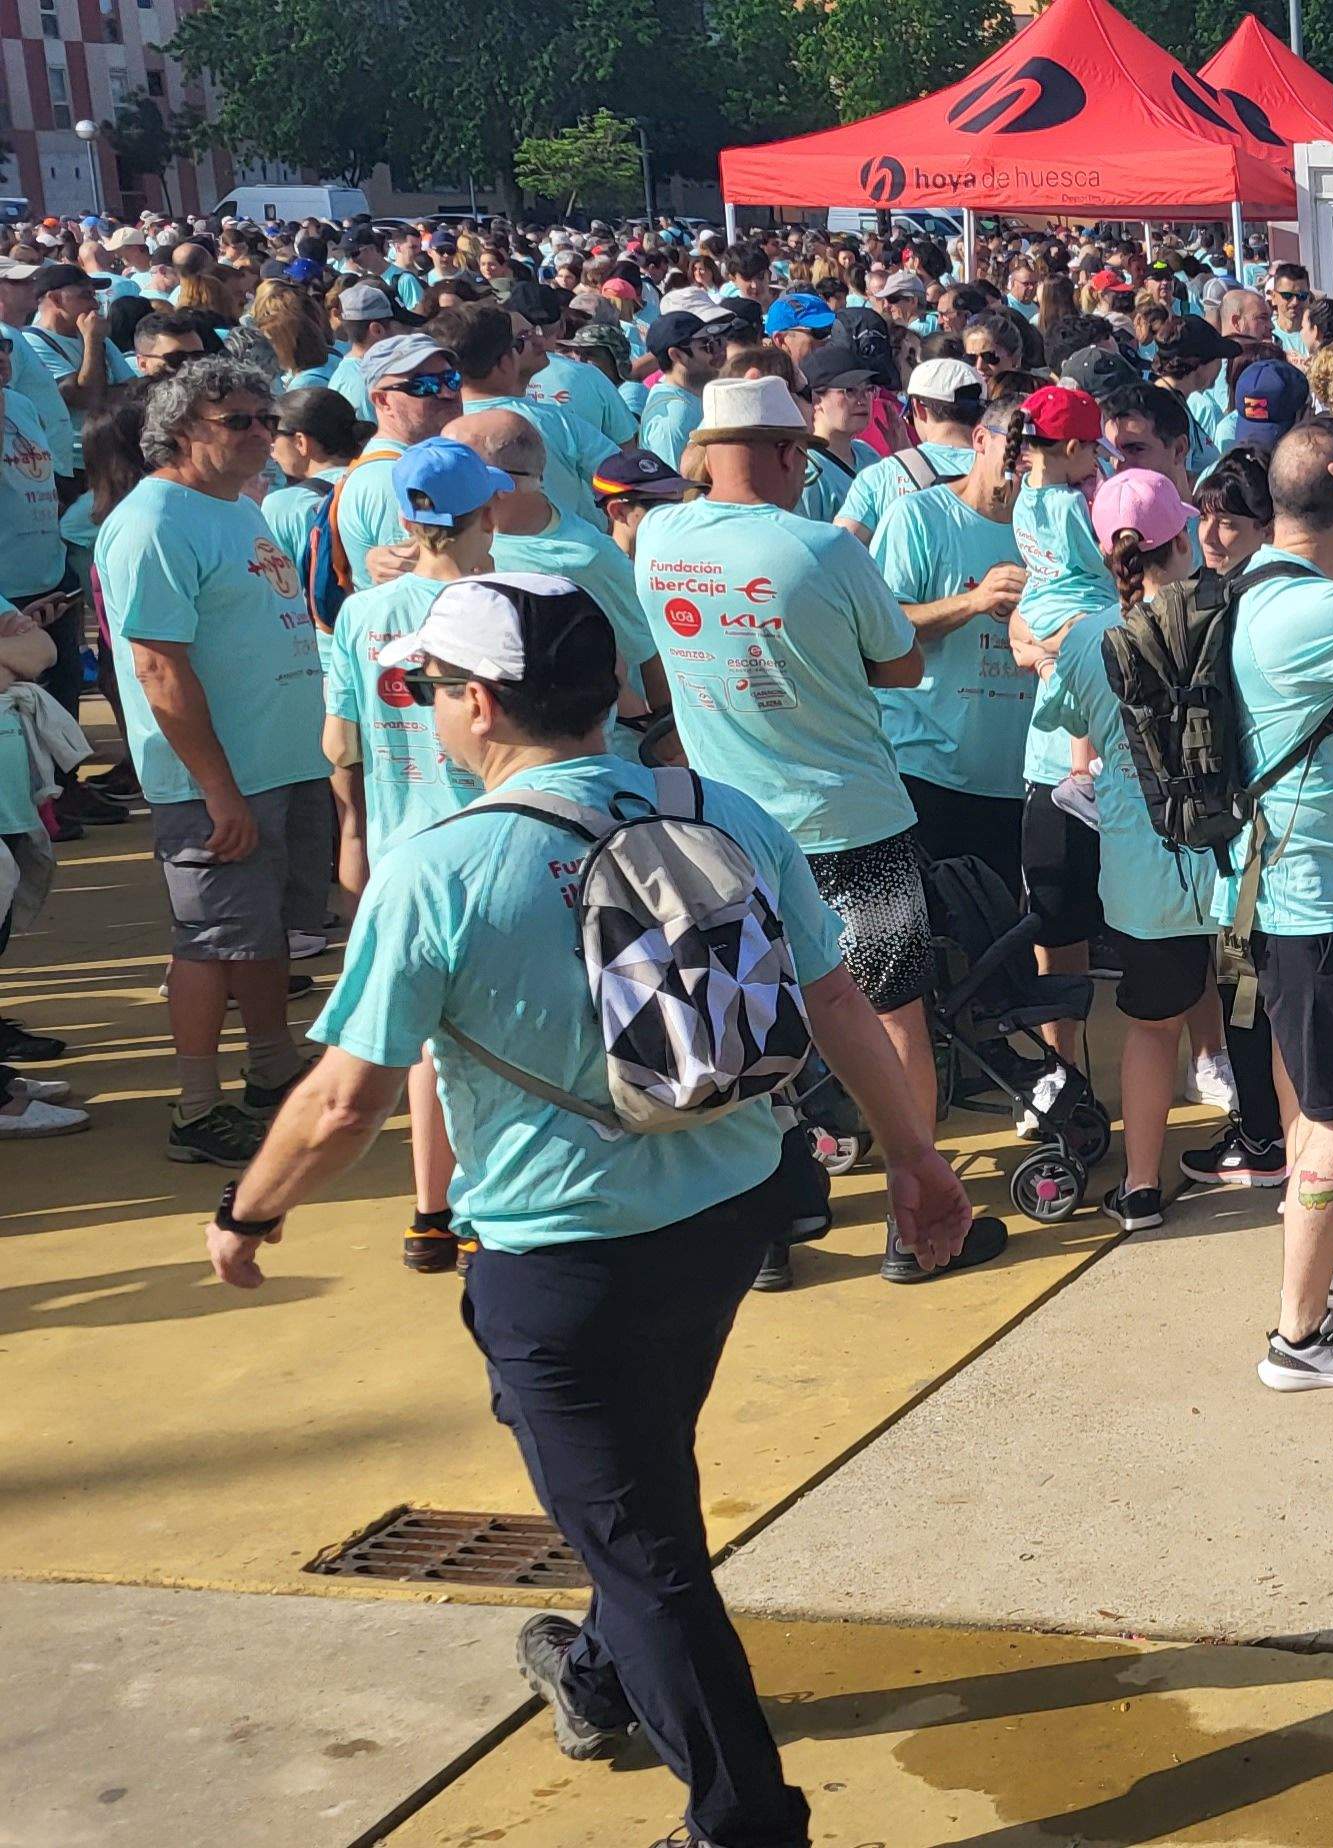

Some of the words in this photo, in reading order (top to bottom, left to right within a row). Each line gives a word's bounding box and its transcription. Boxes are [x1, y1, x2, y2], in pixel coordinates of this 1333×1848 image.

[914, 167, 976, 193] hoya
[982, 167, 1010, 188] de
[1016, 167, 1101, 188] huesca
[650, 559, 722, 575] Fundación
[650, 577, 727, 597] iberCaja
